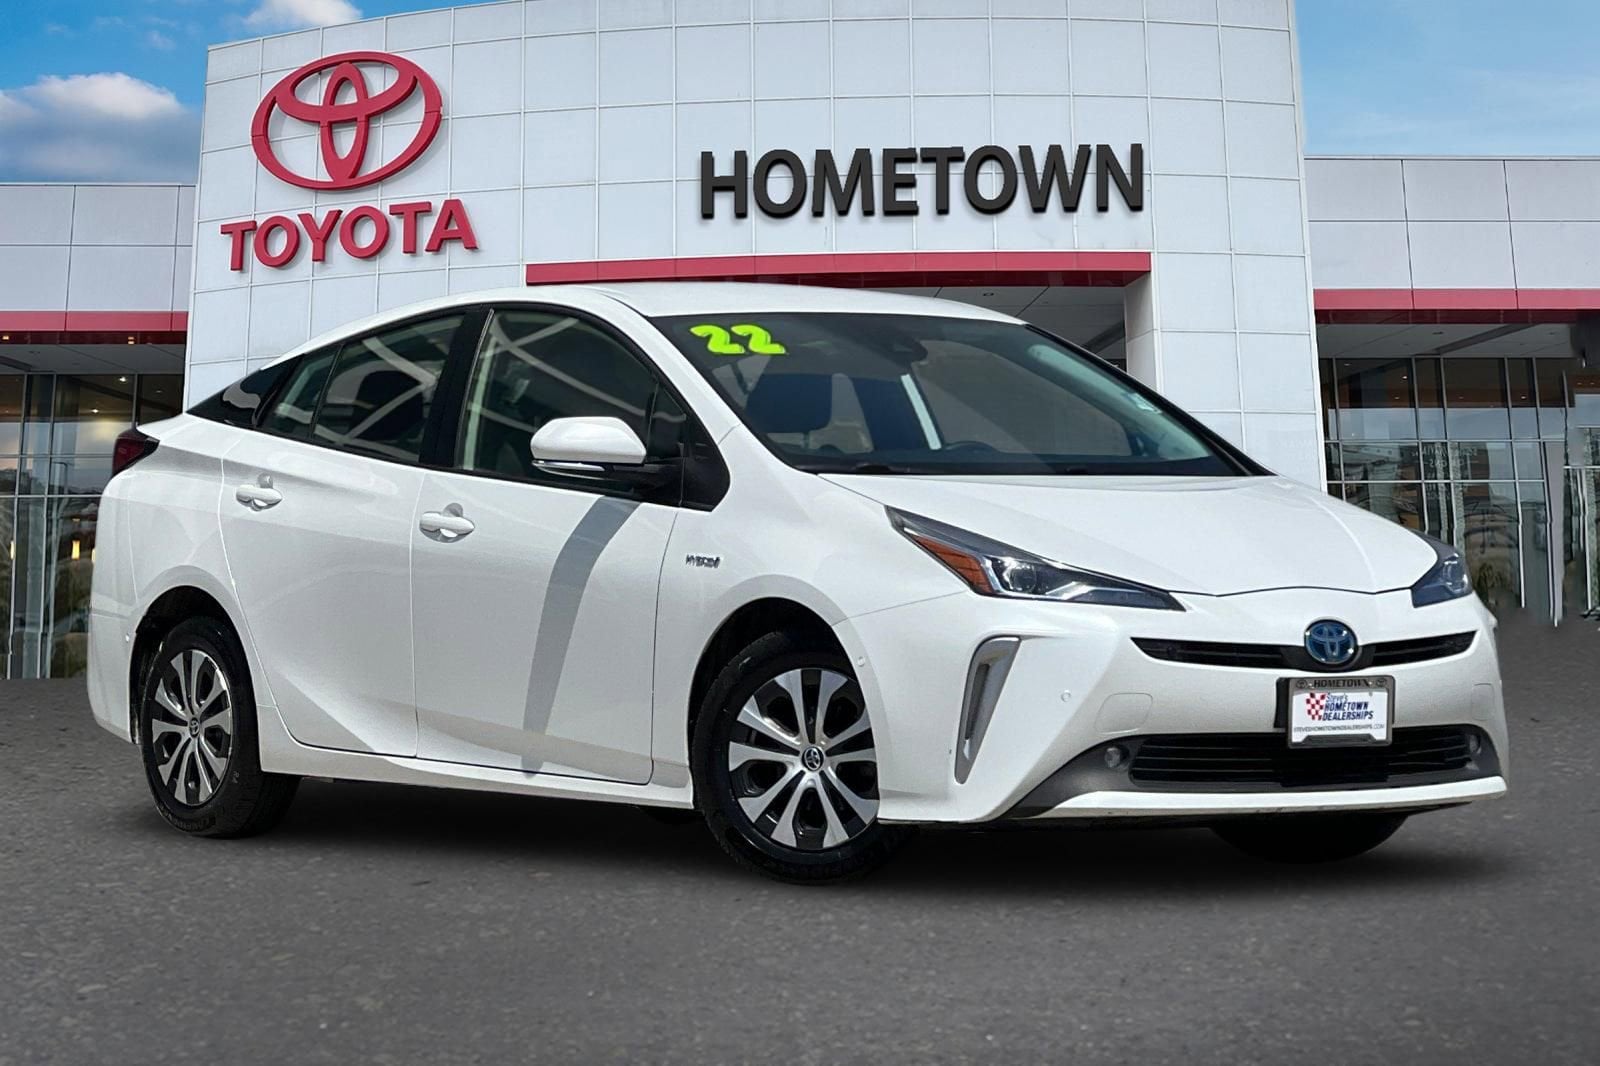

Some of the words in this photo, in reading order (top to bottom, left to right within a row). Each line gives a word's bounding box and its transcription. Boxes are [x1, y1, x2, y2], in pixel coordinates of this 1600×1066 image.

[700, 143, 1144, 218] HOMETOWN
[220, 198, 479, 271] TOYOTA
[690, 324, 786, 354] 22
[1313, 679, 1369, 688] HOMETOWN
[1322, 710, 1374, 720] DEALERSHIPS
[1324, 701, 1368, 711] HOMETOWN
